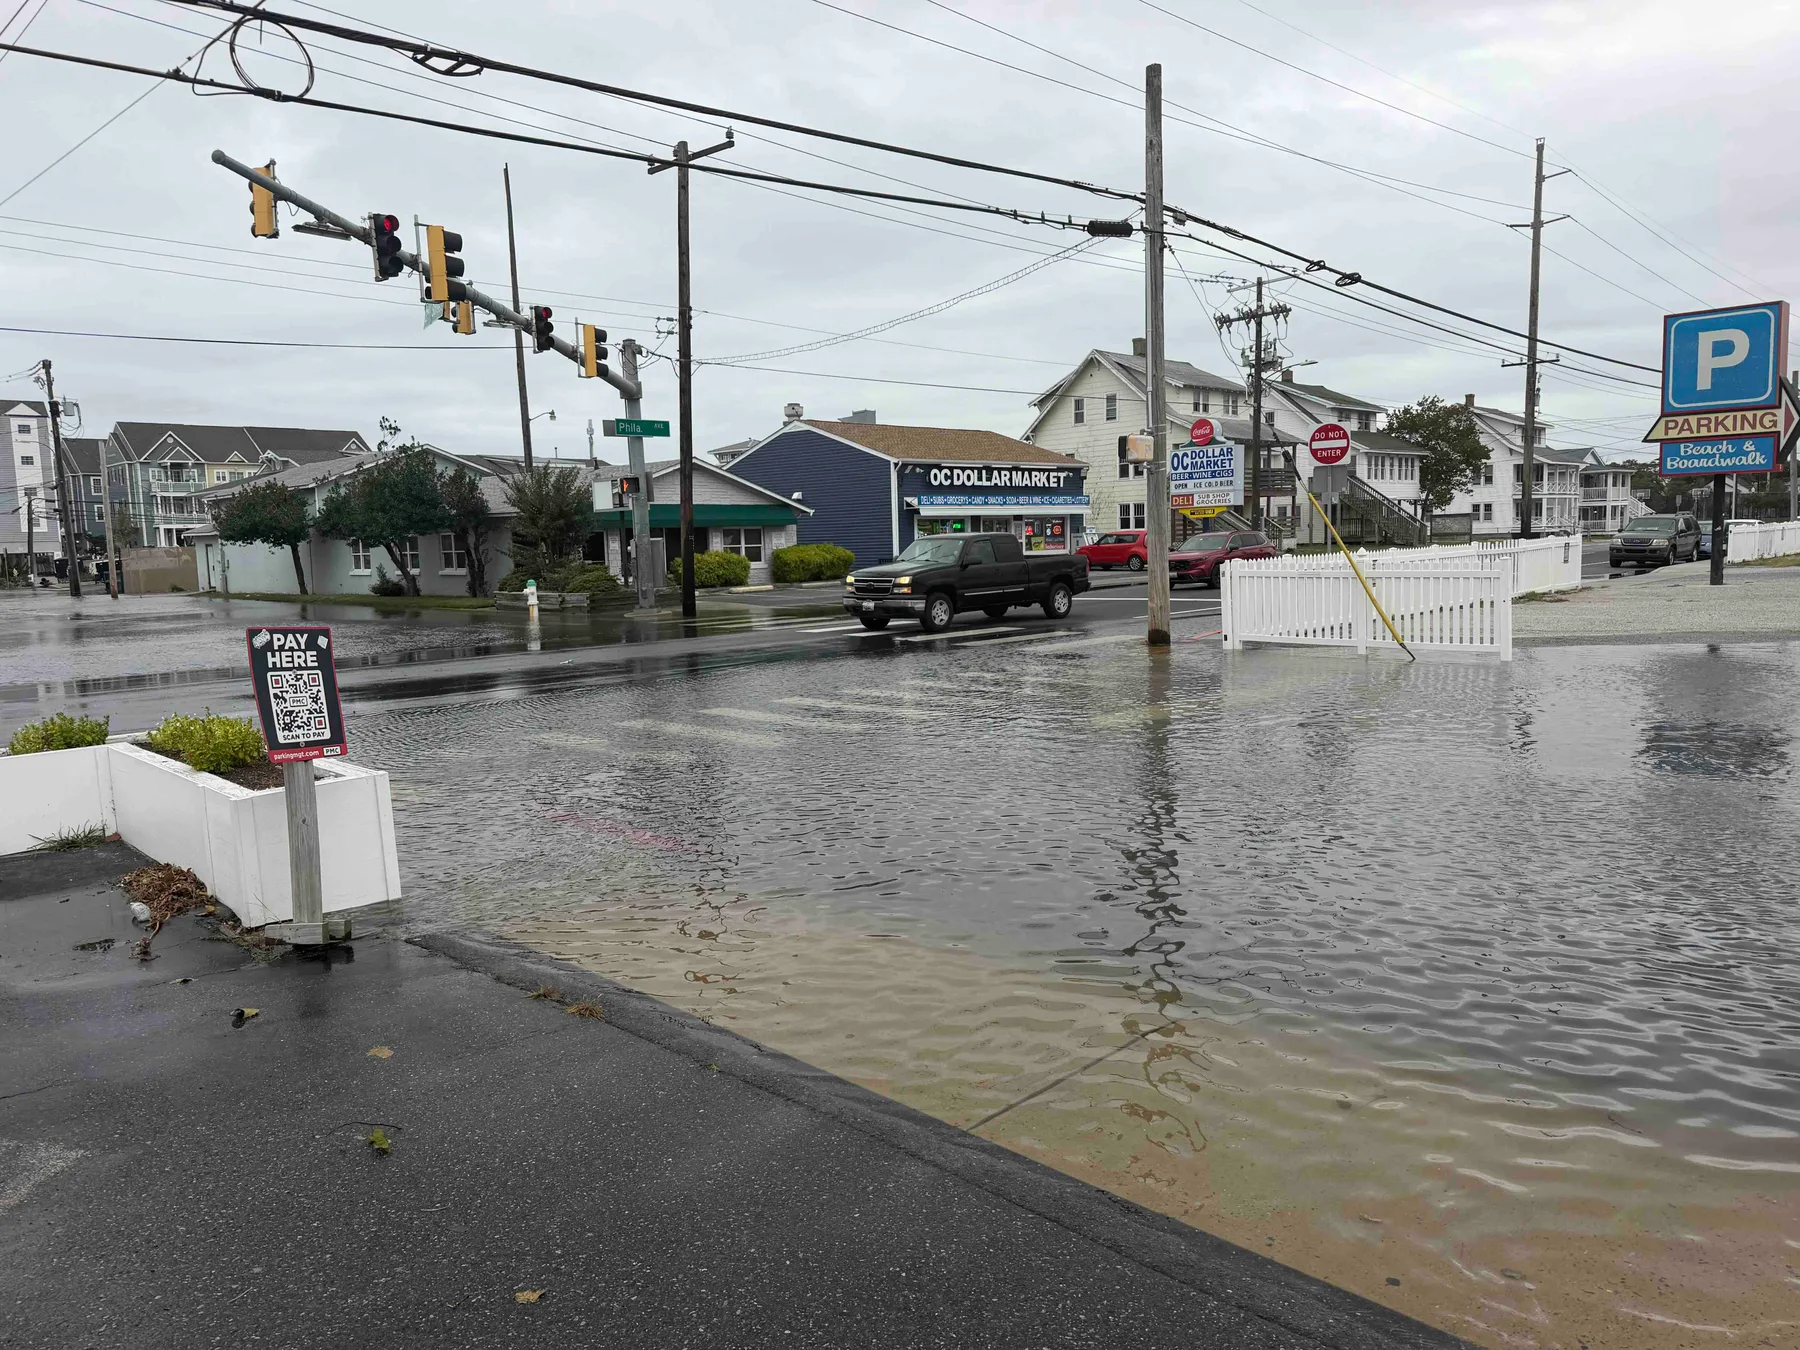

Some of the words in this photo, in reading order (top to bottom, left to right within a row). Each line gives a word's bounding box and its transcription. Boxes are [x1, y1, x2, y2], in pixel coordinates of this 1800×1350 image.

[1697, 328, 1750, 390] P
[619, 422, 642, 432] Phila.
[1664, 412, 1778, 436] PARKING
[1680, 440, 1736, 456] Beach
[1743, 440, 1756, 452] &
[1171, 452, 1189, 471] OC
[1190, 448, 1233, 460] DOLLAR
[1190, 458, 1233, 471] MARKET
[1666, 452, 1768, 470] Boardwalk
[930, 469, 951, 486] OC
[953, 469, 1011, 486] DOLLAR
[1012, 471, 1067, 487] MARKET
[1173, 496, 1192, 505] DELI
[272, 634, 308, 650] PAY
[266, 651, 318, 668] HERE
[274, 750, 319, 760] parkingmgt.com
